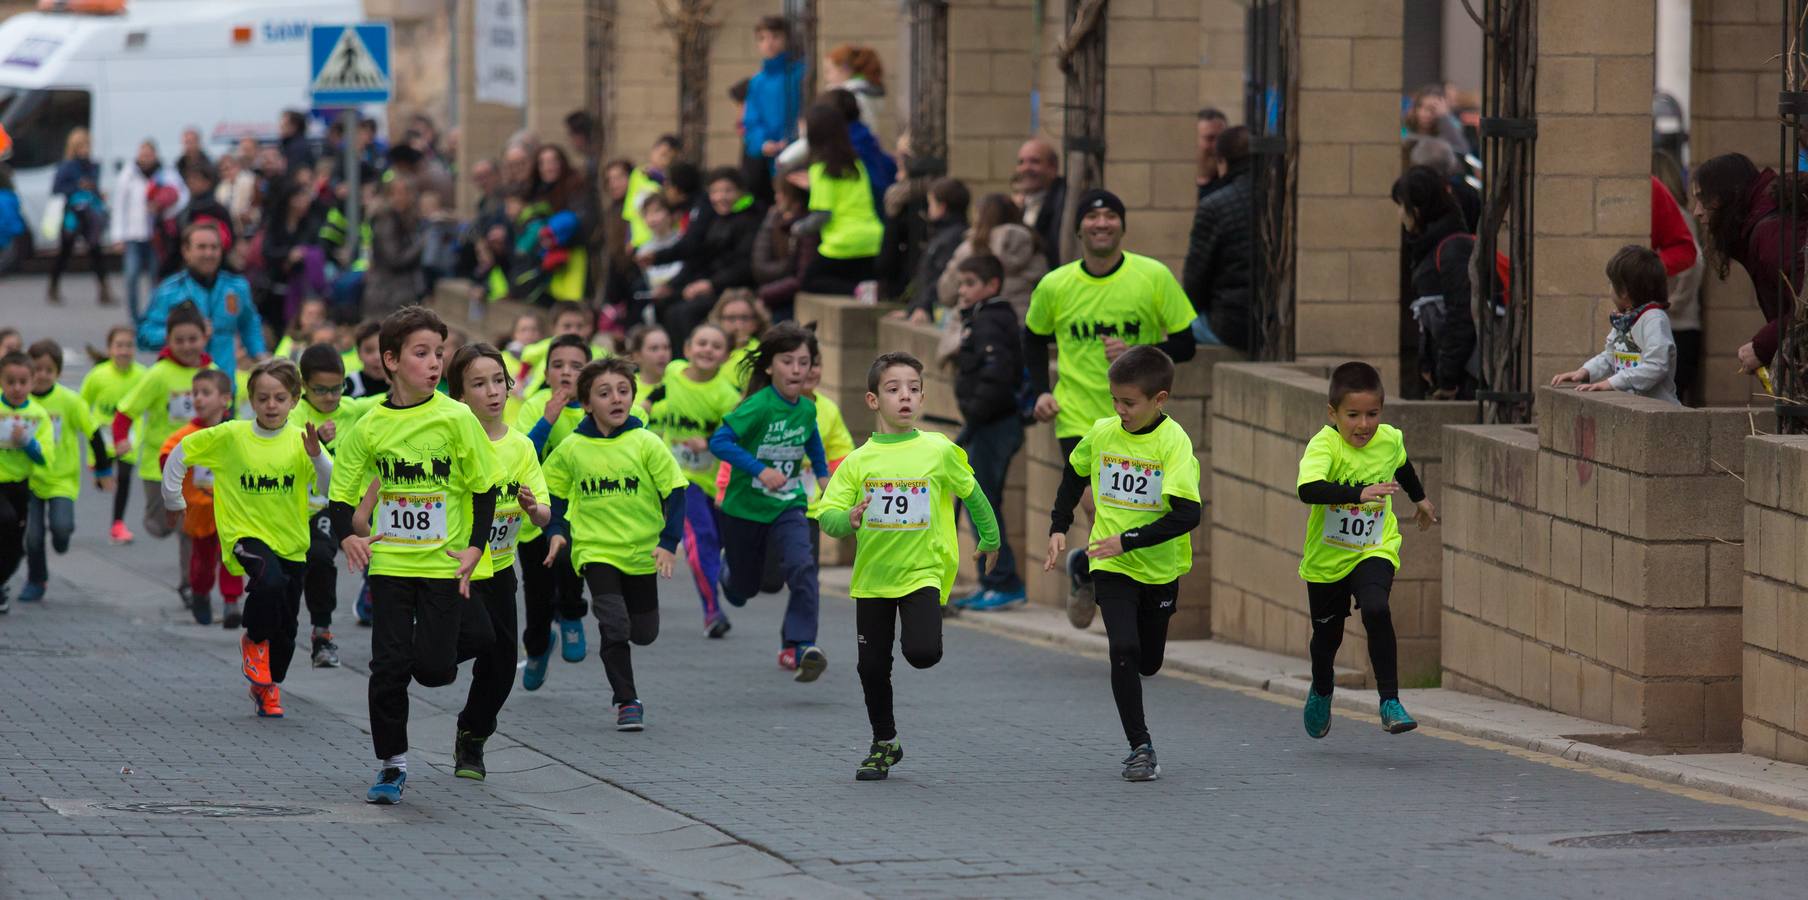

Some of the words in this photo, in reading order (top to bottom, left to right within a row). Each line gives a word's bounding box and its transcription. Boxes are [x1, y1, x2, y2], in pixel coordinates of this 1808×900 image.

[895, 480, 926, 488] silvestre
[1111, 471, 1148, 495] 102
[881, 495, 908, 515] 79
[391, 509, 431, 531] 108
[1338, 517, 1375, 537] 103
